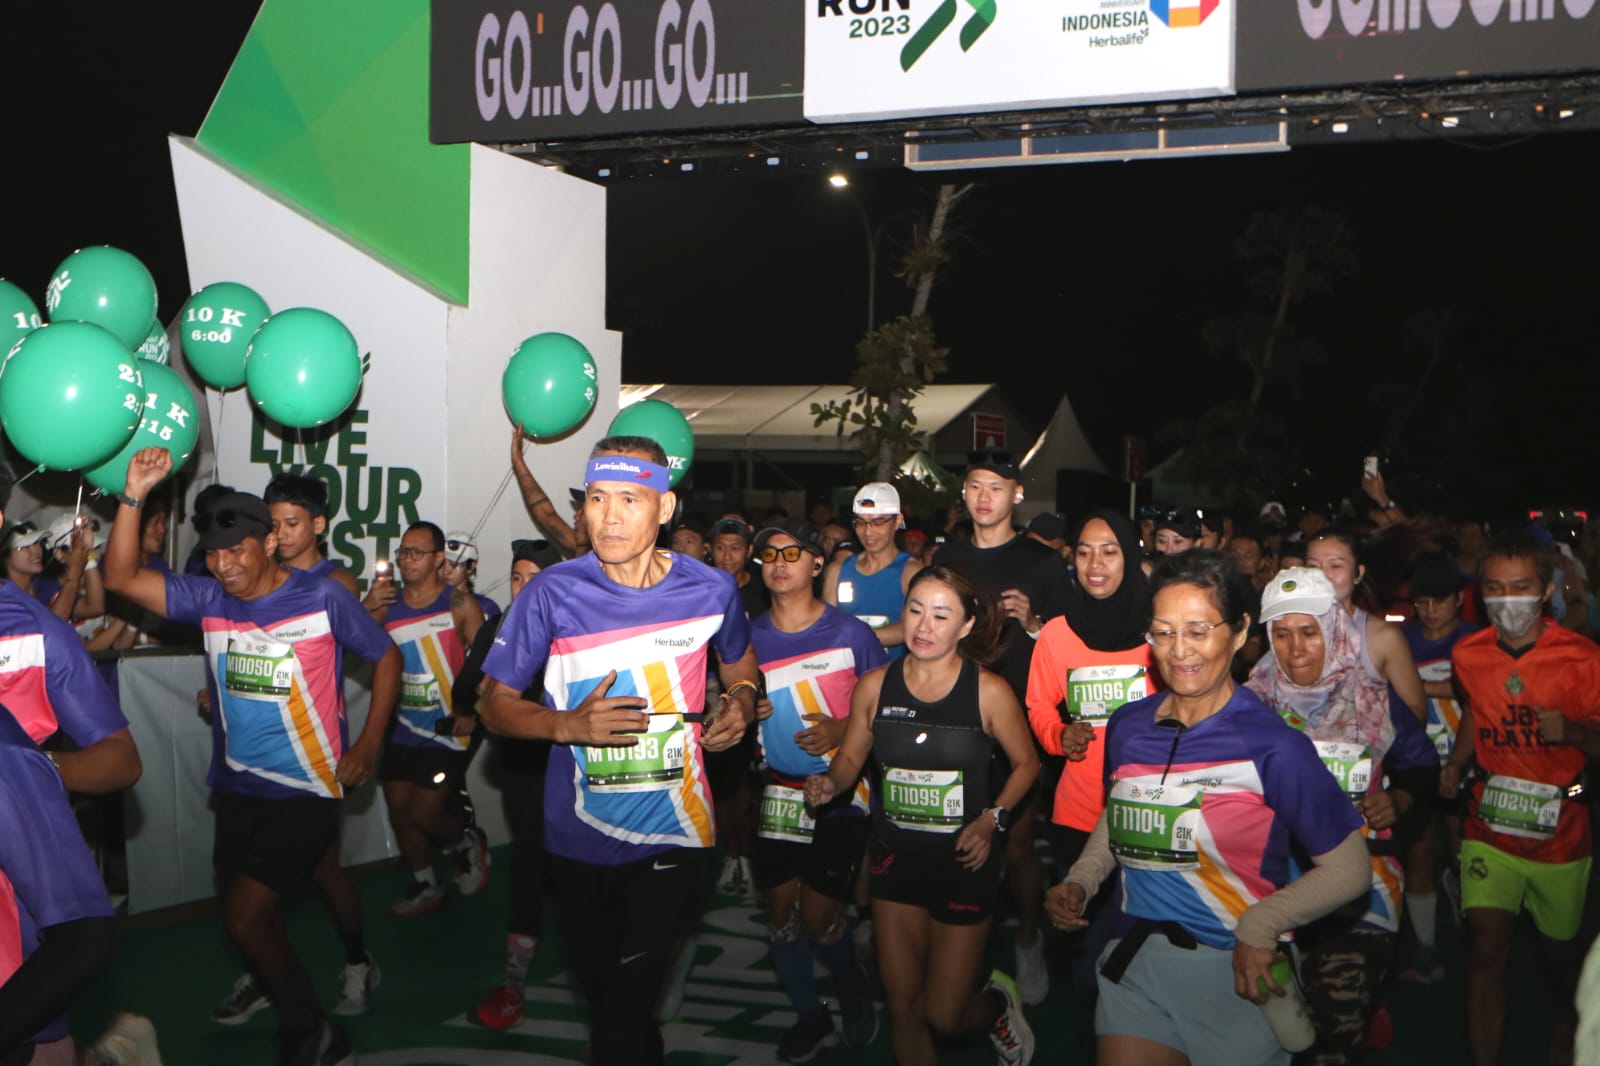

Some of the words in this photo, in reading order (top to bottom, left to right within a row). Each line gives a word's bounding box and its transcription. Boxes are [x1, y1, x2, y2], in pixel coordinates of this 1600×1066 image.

[849, 14, 910, 38] 2023
[1062, 10, 1149, 32] INDONESIA
[1089, 34, 1144, 48] Herbalife
[13, 312, 41, 329] 10
[186, 306, 213, 322] 10
[219, 307, 247, 328] K
[166, 401, 189, 428] K
[269, 463, 422, 527] OUR
[655, 637, 690, 648] Herbalife
[1073, 682, 1124, 703] F11096
[587, 737, 660, 763] M10193
[1352, 773, 1368, 783] 21K
[890, 785, 940, 808] F11095
[946, 798, 961, 809] 21K
[1113, 804, 1167, 836] F11104
[1176, 826, 1193, 840] 21K
